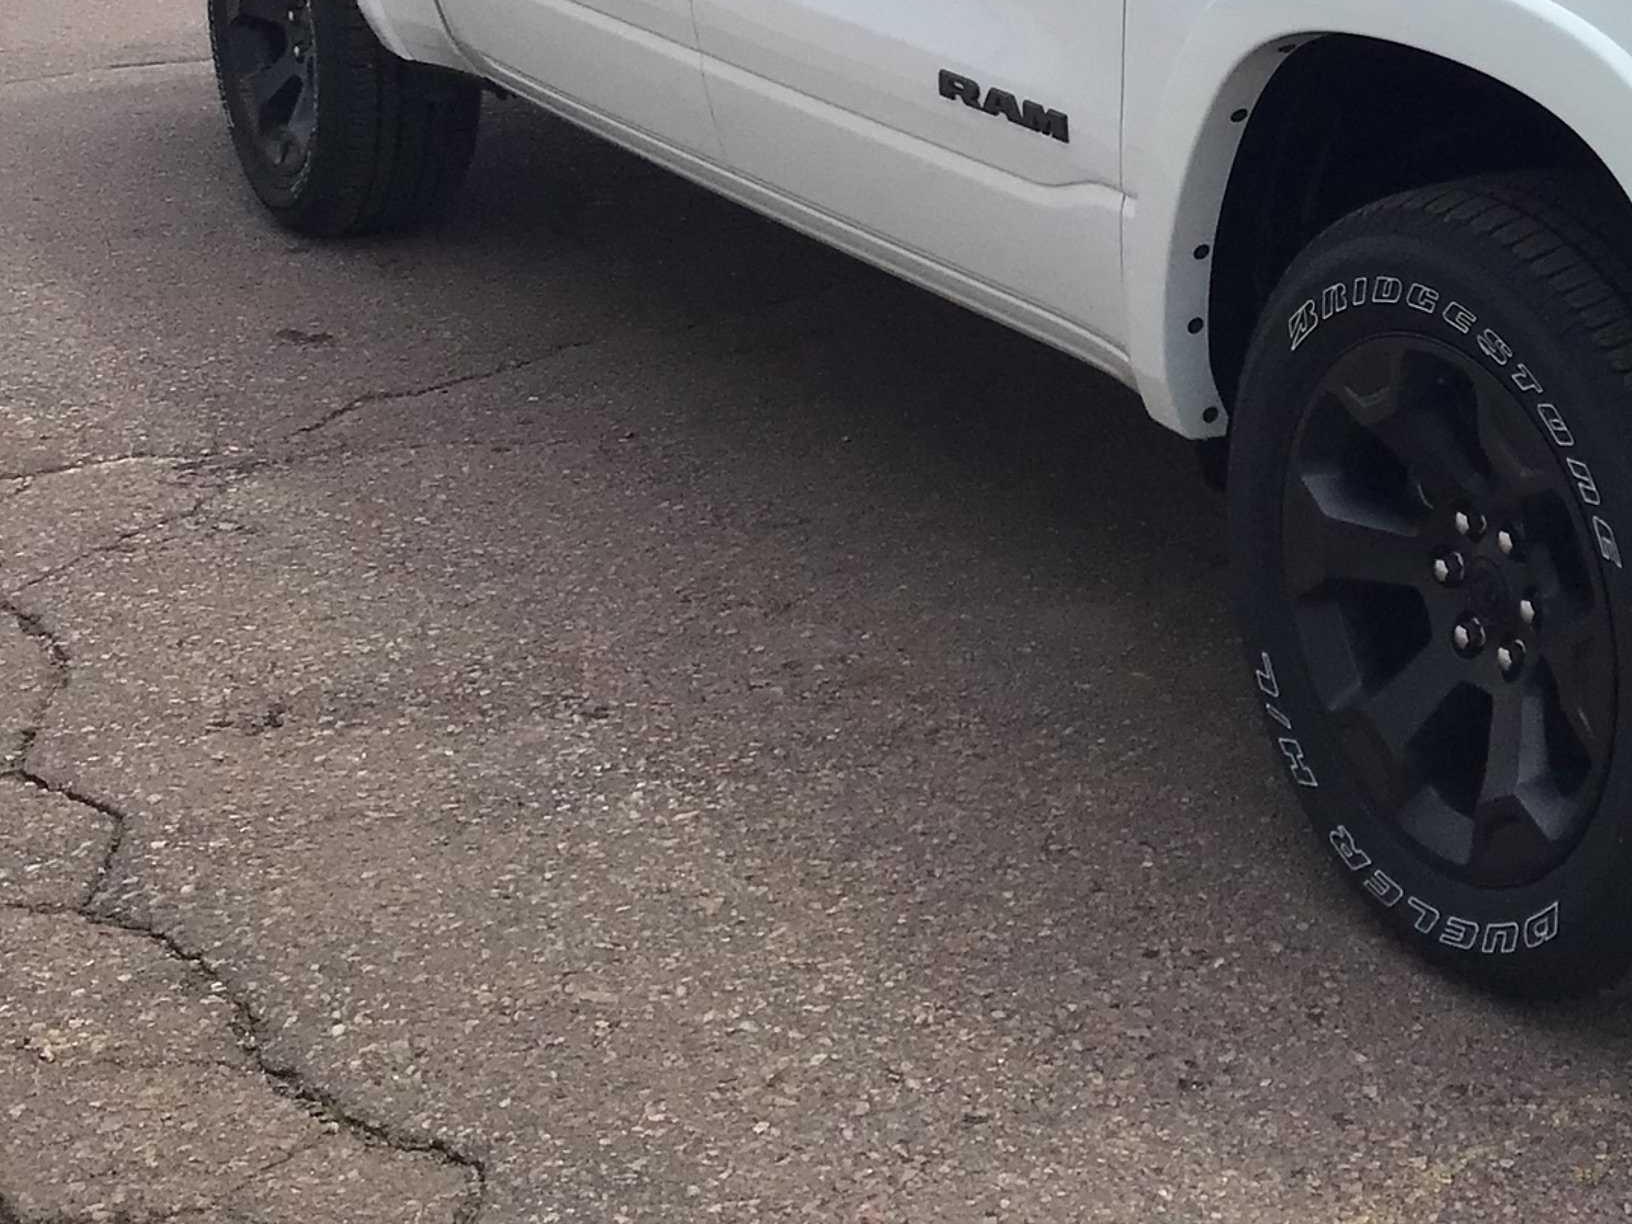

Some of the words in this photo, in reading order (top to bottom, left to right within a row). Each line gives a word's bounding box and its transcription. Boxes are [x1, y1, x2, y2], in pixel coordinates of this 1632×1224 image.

[938, 68, 1070, 144] RAM
[1287, 276, 1622, 569] BRIDGESTONE
[1255, 651, 1318, 788] H/L
[1328, 824, 1561, 954] DUELER
